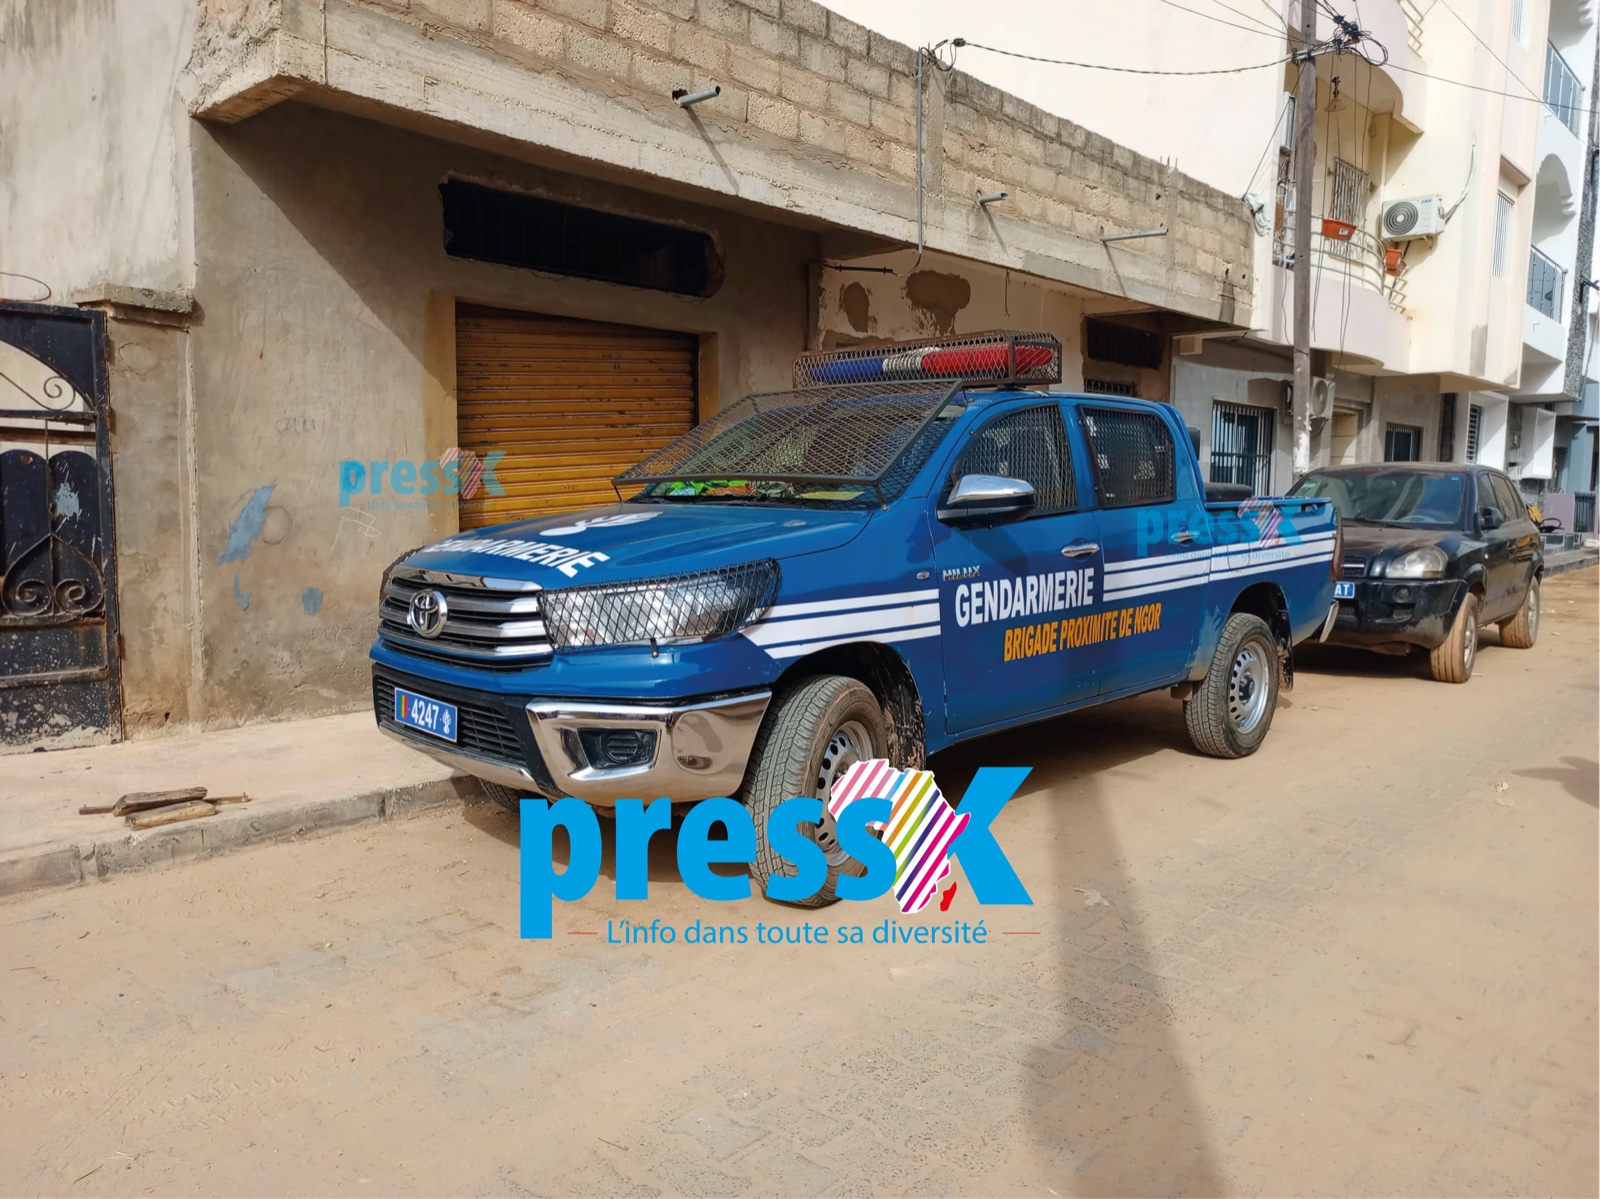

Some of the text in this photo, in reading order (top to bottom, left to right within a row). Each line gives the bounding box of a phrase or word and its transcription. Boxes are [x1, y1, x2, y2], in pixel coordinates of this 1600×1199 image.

[943, 565, 981, 581] HILUX
[955, 567, 1095, 628] GENDARMERIE
[1004, 602, 1162, 662] BRIGADE PROXIMITE DE NGOR
[411, 698, 440, 730] 4247
